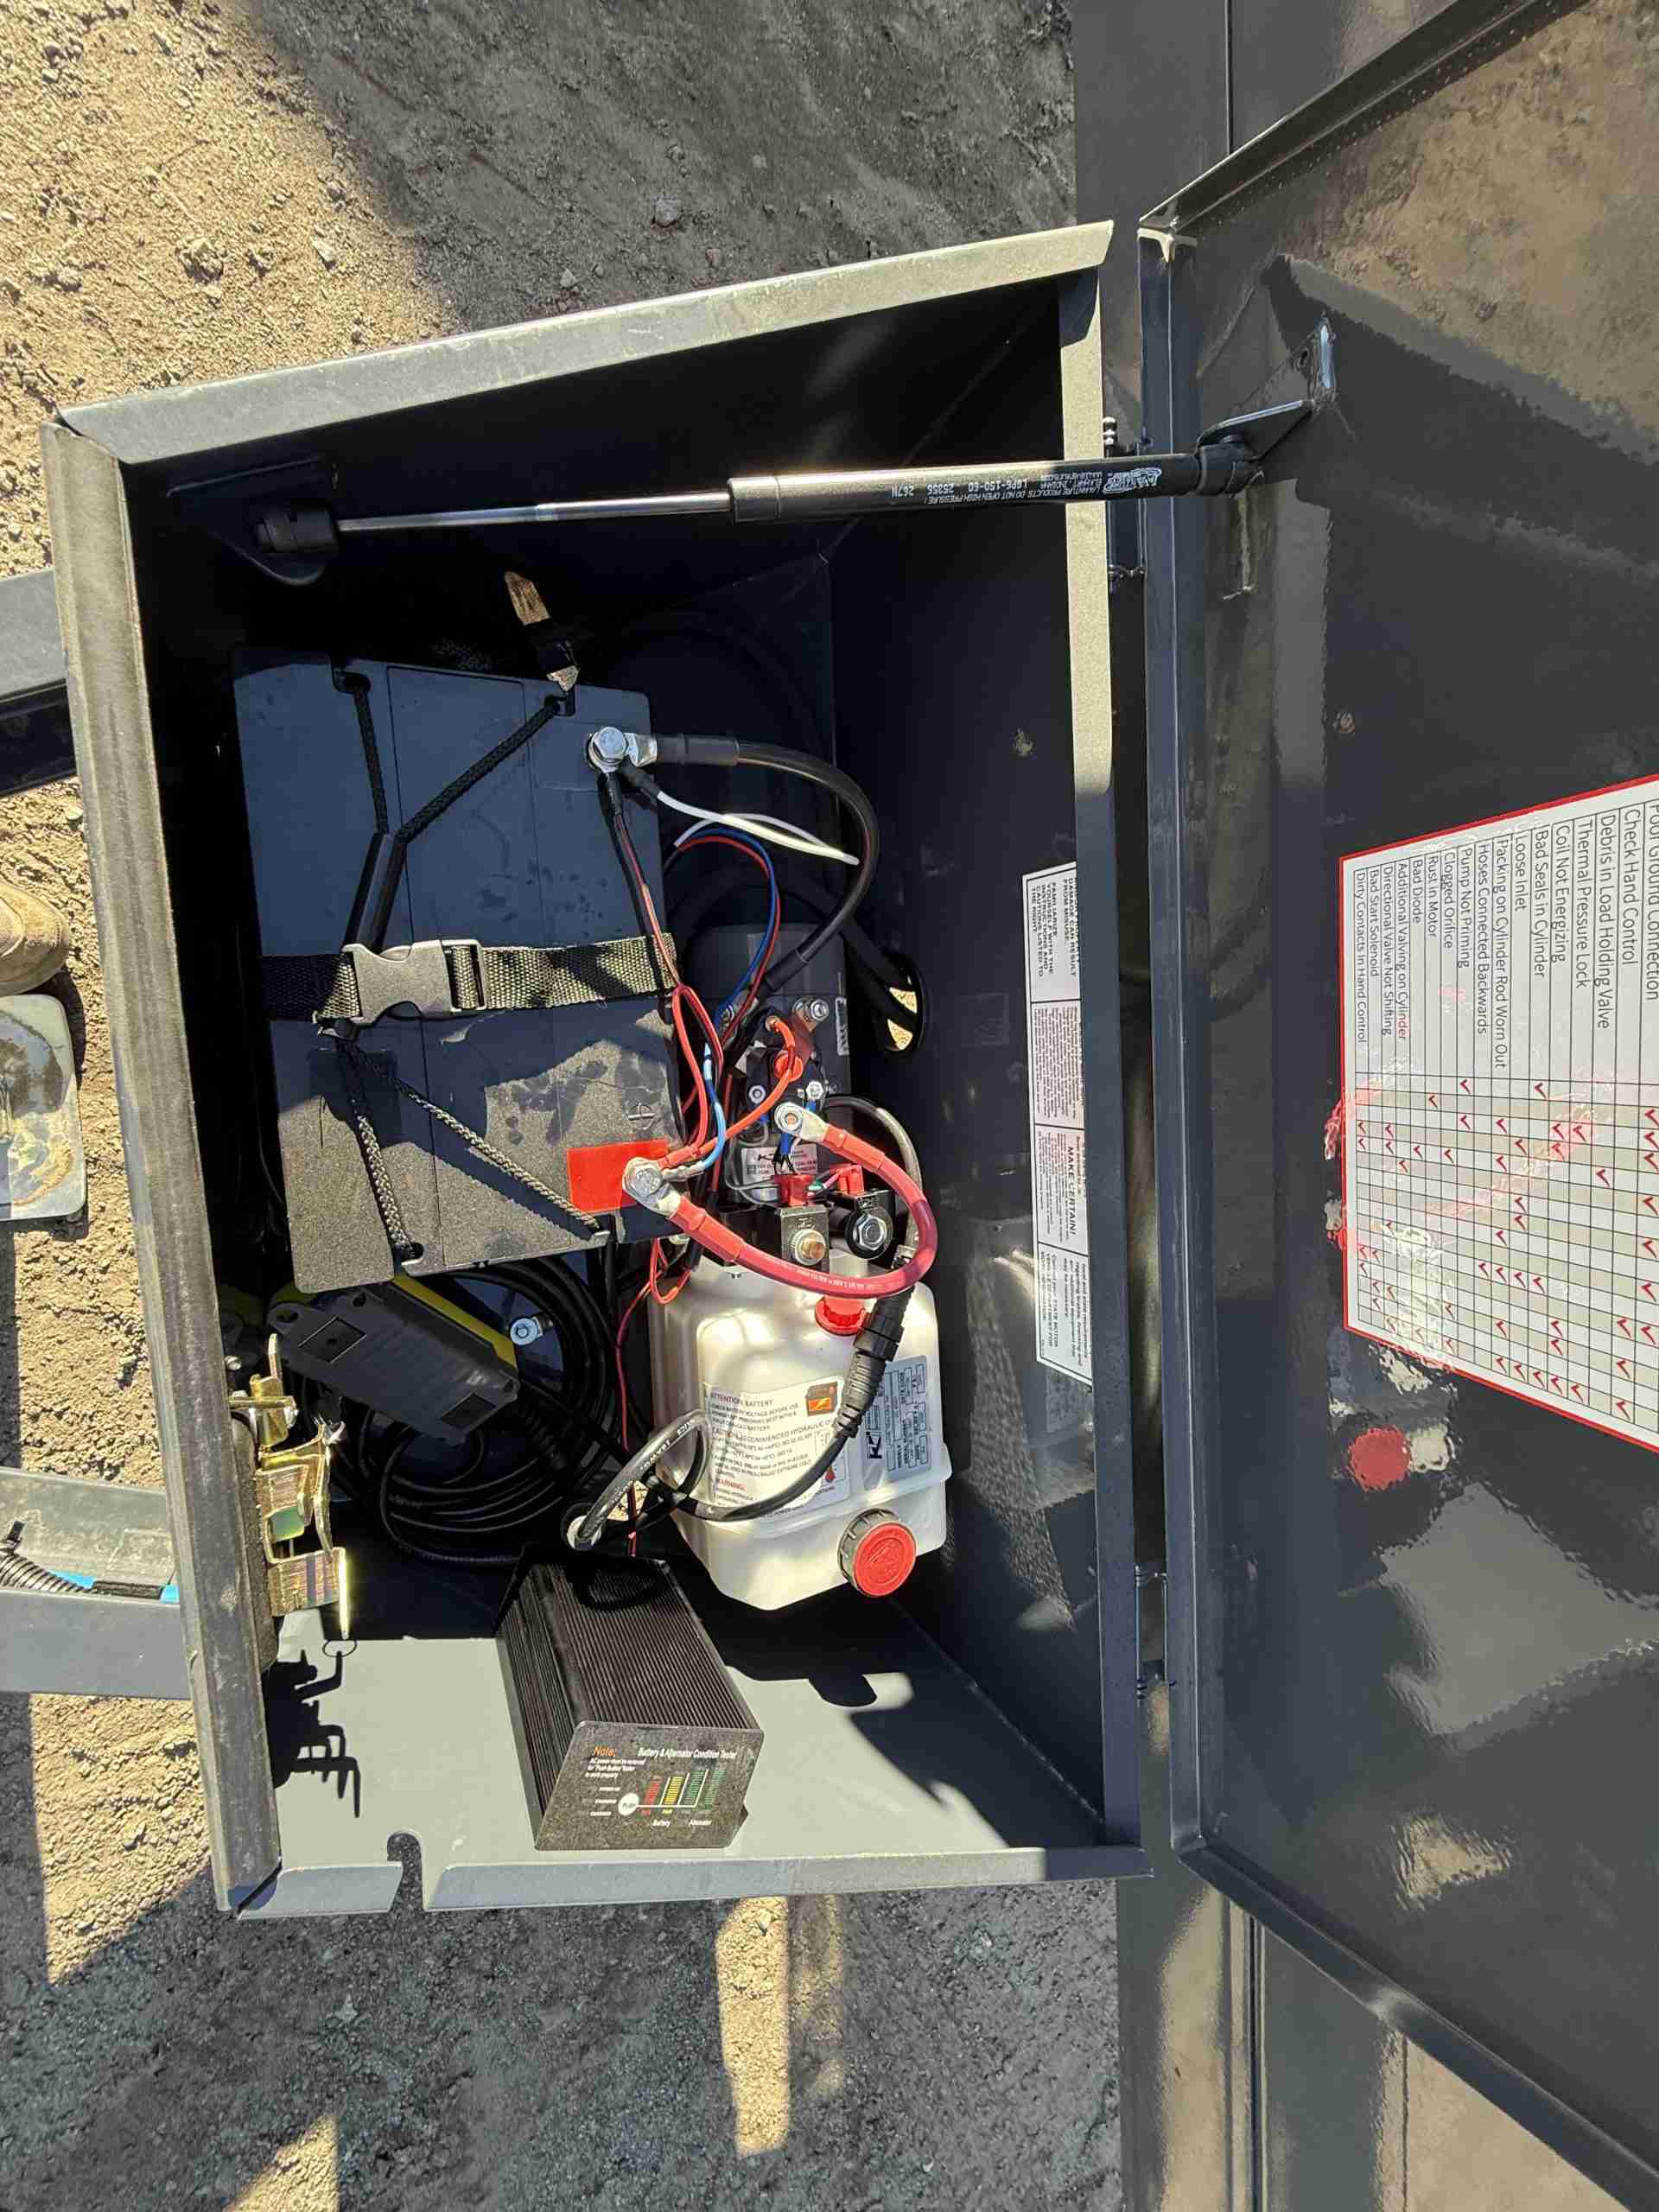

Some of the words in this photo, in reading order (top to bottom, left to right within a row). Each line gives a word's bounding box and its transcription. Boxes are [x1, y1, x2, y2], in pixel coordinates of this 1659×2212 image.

[1535, 830, 1548, 858] Bad
[1556, 826, 1569, 854] Coil
[1578, 820, 1592, 882] Thermal
[1601, 815, 1616, 864] Debris
[1624, 810, 1641, 857] Check
[1413, 860, 1423, 883] Bad
[1428, 857, 1439, 883] Rust
[1458, 849, 1473, 887] Pump
[1478, 844, 1490, 885] Hoses
[1493, 840, 1509, 893] Packing
[1516, 836, 1528, 876] Loose
[1556, 857, 1569, 882] Not
[1600, 868, 1614, 881] in
[1355, 873, 1366, 899] Dirty
[1370, 870, 1379, 892] Bad
[1398, 863, 1408, 924] Additional
[1428, 887, 1439, 898] in
[1441, 853, 1455, 904] Clogged
[1516, 880, 1528, 911] Inlet
[1535, 863, 1548, 899] Seals
[1624, 862, 1639, 903] Hand
[1370, 896, 1379, 921] Start
[1383, 867, 1393, 930] Directional
[1413, 887, 1423, 923] Diode
[1461, 891, 1472, 914] Not
[1496, 896, 1506, 913] on
[1535, 904, 1548, 916] in
[1599, 886, 1614, 922] Load
[1357, 903, 1366, 951] Contacts
[1428, 901, 1439, 937] Motor
[1444, 908, 1455, 949] Orifice
[1478, 887, 1490, 959] Connected
[1551, 887, 1569, 963] Energizing
[1576, 887, 1591, 950] Pressure
[1622, 908, 1638, 964] Control
[1357, 955, 1366, 965] in
[1370, 926, 1379, 976] Solenoid
[1383, 933, 1393, 964] Valve
[1395, 928, 1408, 970] Valving
[1458, 918, 1472, 968] Priming
[1493, 917, 1509, 971] Cylinder
[1531, 920, 1548, 977] Cylinder
[1594, 927, 1613, 986] Holding
[1357, 969, 1367, 998] Hand
[1383, 968, 1393, 988] Not
[1398, 974, 1406, 988] on
[1496, 976, 1508, 1001] Rod
[1576, 954, 1591, 988] Lock
[1382, 992, 1394, 1036] Shifting
[1395, 992, 1408, 1039] Cylinder
[1478, 963, 1489, 1033] Backwards
[1599, 990, 1612, 1028] Valve
[1357, 1001, 1367, 1042] Control
[1496, 1006, 1507, 1039] Worn
[1496, 1045, 1507, 1069] Out
[594, 1746, 616, 1757] Note:
